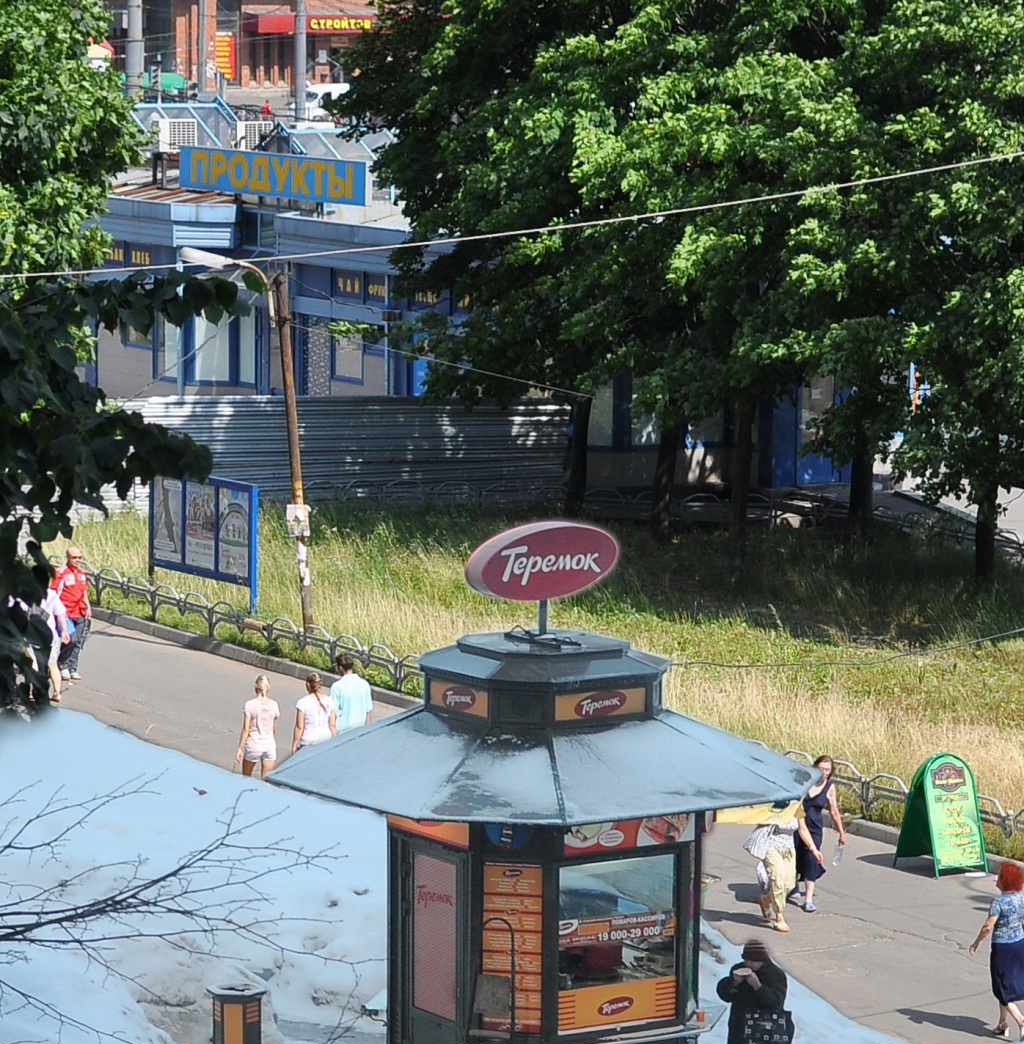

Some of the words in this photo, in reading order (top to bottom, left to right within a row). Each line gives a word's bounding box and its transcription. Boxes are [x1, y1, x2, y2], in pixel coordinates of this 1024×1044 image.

[190, 150, 353, 200] ПРОДУКТЫ
[338, 277, 360, 294] ЧАЙ
[500, 545, 601, 586] Теремок
[446, 690, 472, 704] Теремок
[580, 696, 621, 715] Теремок
[416, 884, 453, 908] Теремок
[598, 932, 608, 942] 19
[643, 927, 660, 936] 000
[601, 1000, 631, 1014] Теремок
